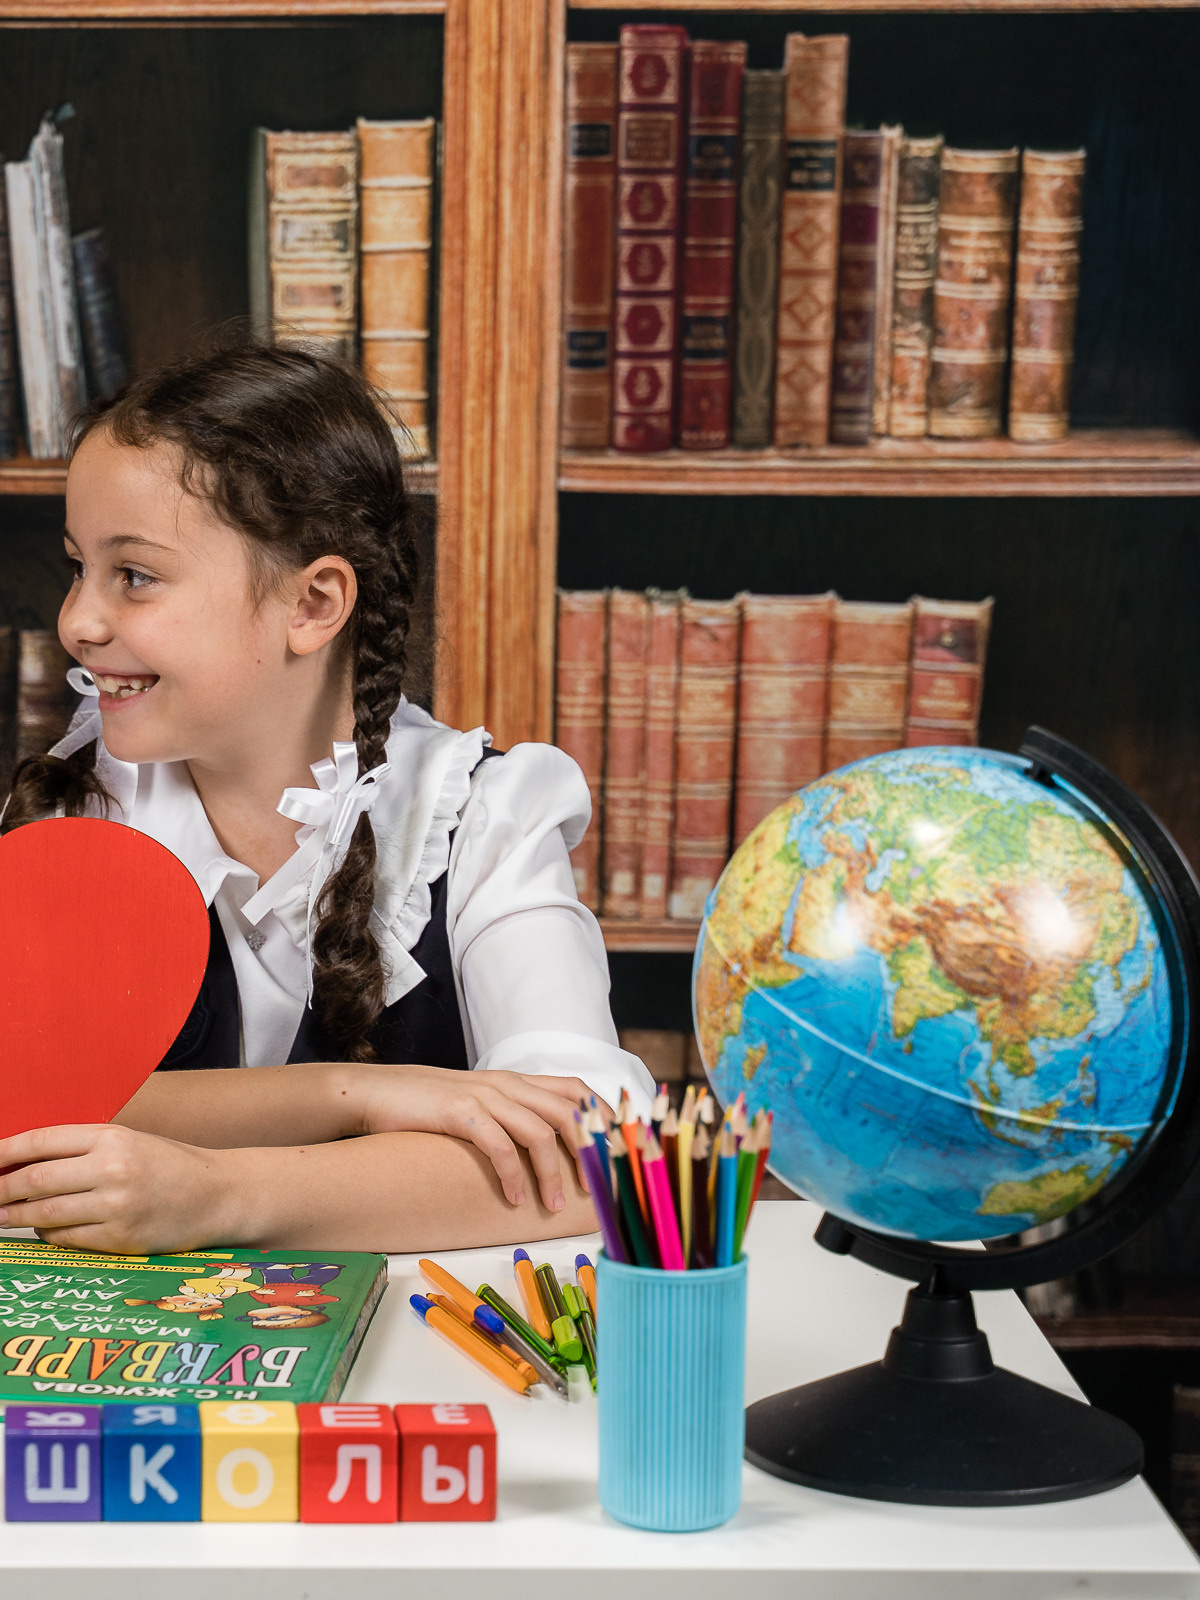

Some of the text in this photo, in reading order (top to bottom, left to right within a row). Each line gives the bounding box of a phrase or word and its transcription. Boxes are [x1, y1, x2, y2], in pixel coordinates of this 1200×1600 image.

[113, 1264, 198, 1272] СОЧЕТАНИЕ
[33, 1274, 129, 1286] ЛУ-НА
[52, 1288, 123, 1300] АМ
[19, 1300, 114, 1313] РО-ЗА
[16, 1312, 58, 1322] УС
[73, 1315, 159, 1326] МЫ-ЛО
[51, 1321, 192, 1337] МА-МА
[2, 1335, 309, 1388] БУКВАРЬ
[32, 1382, 181, 1398] ЖУКОВА
